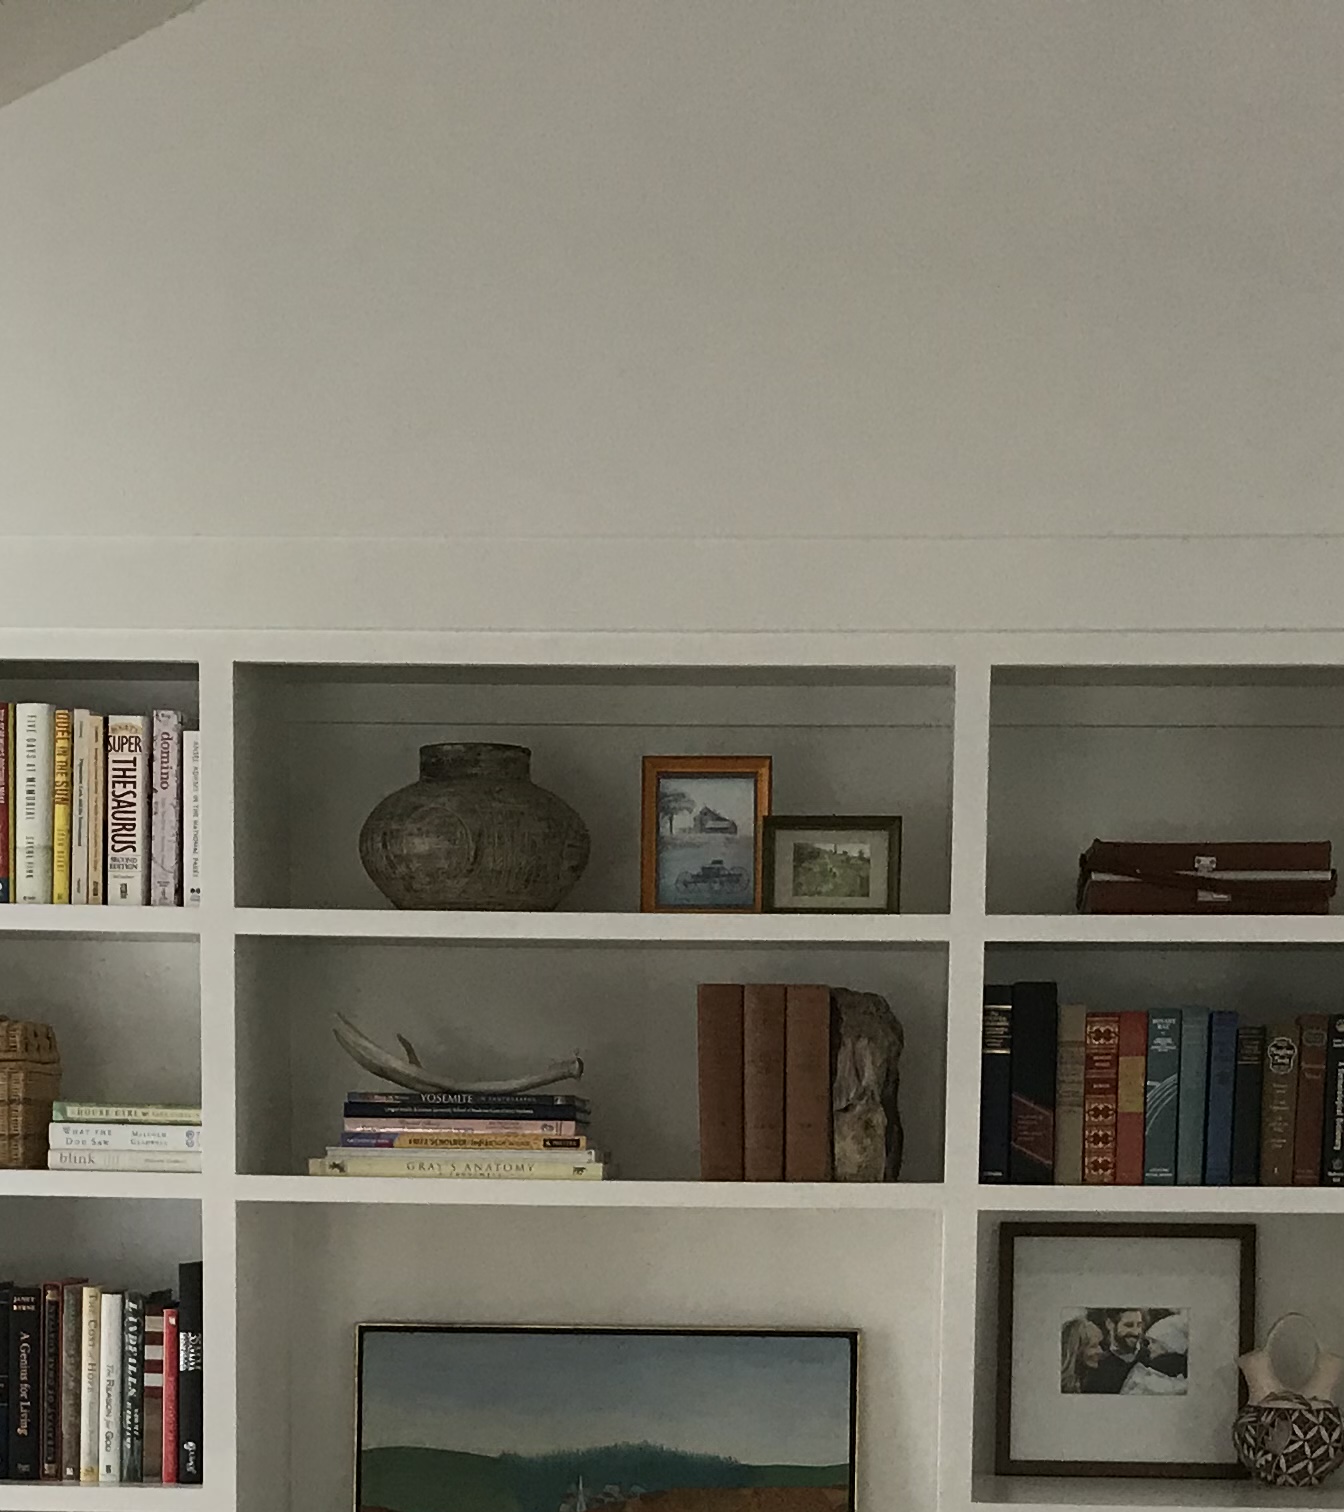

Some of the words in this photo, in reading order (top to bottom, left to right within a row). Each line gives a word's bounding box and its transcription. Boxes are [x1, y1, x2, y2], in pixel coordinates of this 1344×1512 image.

[26, 714, 38, 733] FIVE
[56, 712, 71, 744] DUEL
[26, 738, 38, 760] DAYS
[56, 746, 69, 756] IN
[106, 735, 142, 752] SUPER
[26, 763, 37, 772] AT
[56, 760, 69, 778] THE
[160, 732, 174, 790] domino
[26, 776, 37, 822] MEMORIAL
[55, 780, 70, 806] SUN
[110, 756, 137, 854] THESAURUS
[420, 1094, 474, 1104] YOSEMITE
[76, 1108, 110, 1118] HOUSE
[114, 1108, 138, 1118] GIRL
[59, 1152, 96, 1166] blink
[464, 1164, 536, 1173] ANATOMY
[20, 1332, 30, 1340] A
[88, 1319, 97, 1348] COST
[20, 1342, 30, 1380] Genius
[88, 1362, 97, 1393] HOPE
[20, 1384, 30, 1398] for
[106, 1378, 114, 1416] REASON
[17, 1401, 30, 1436] Living
[105, 1430, 114, 1452] GOD
